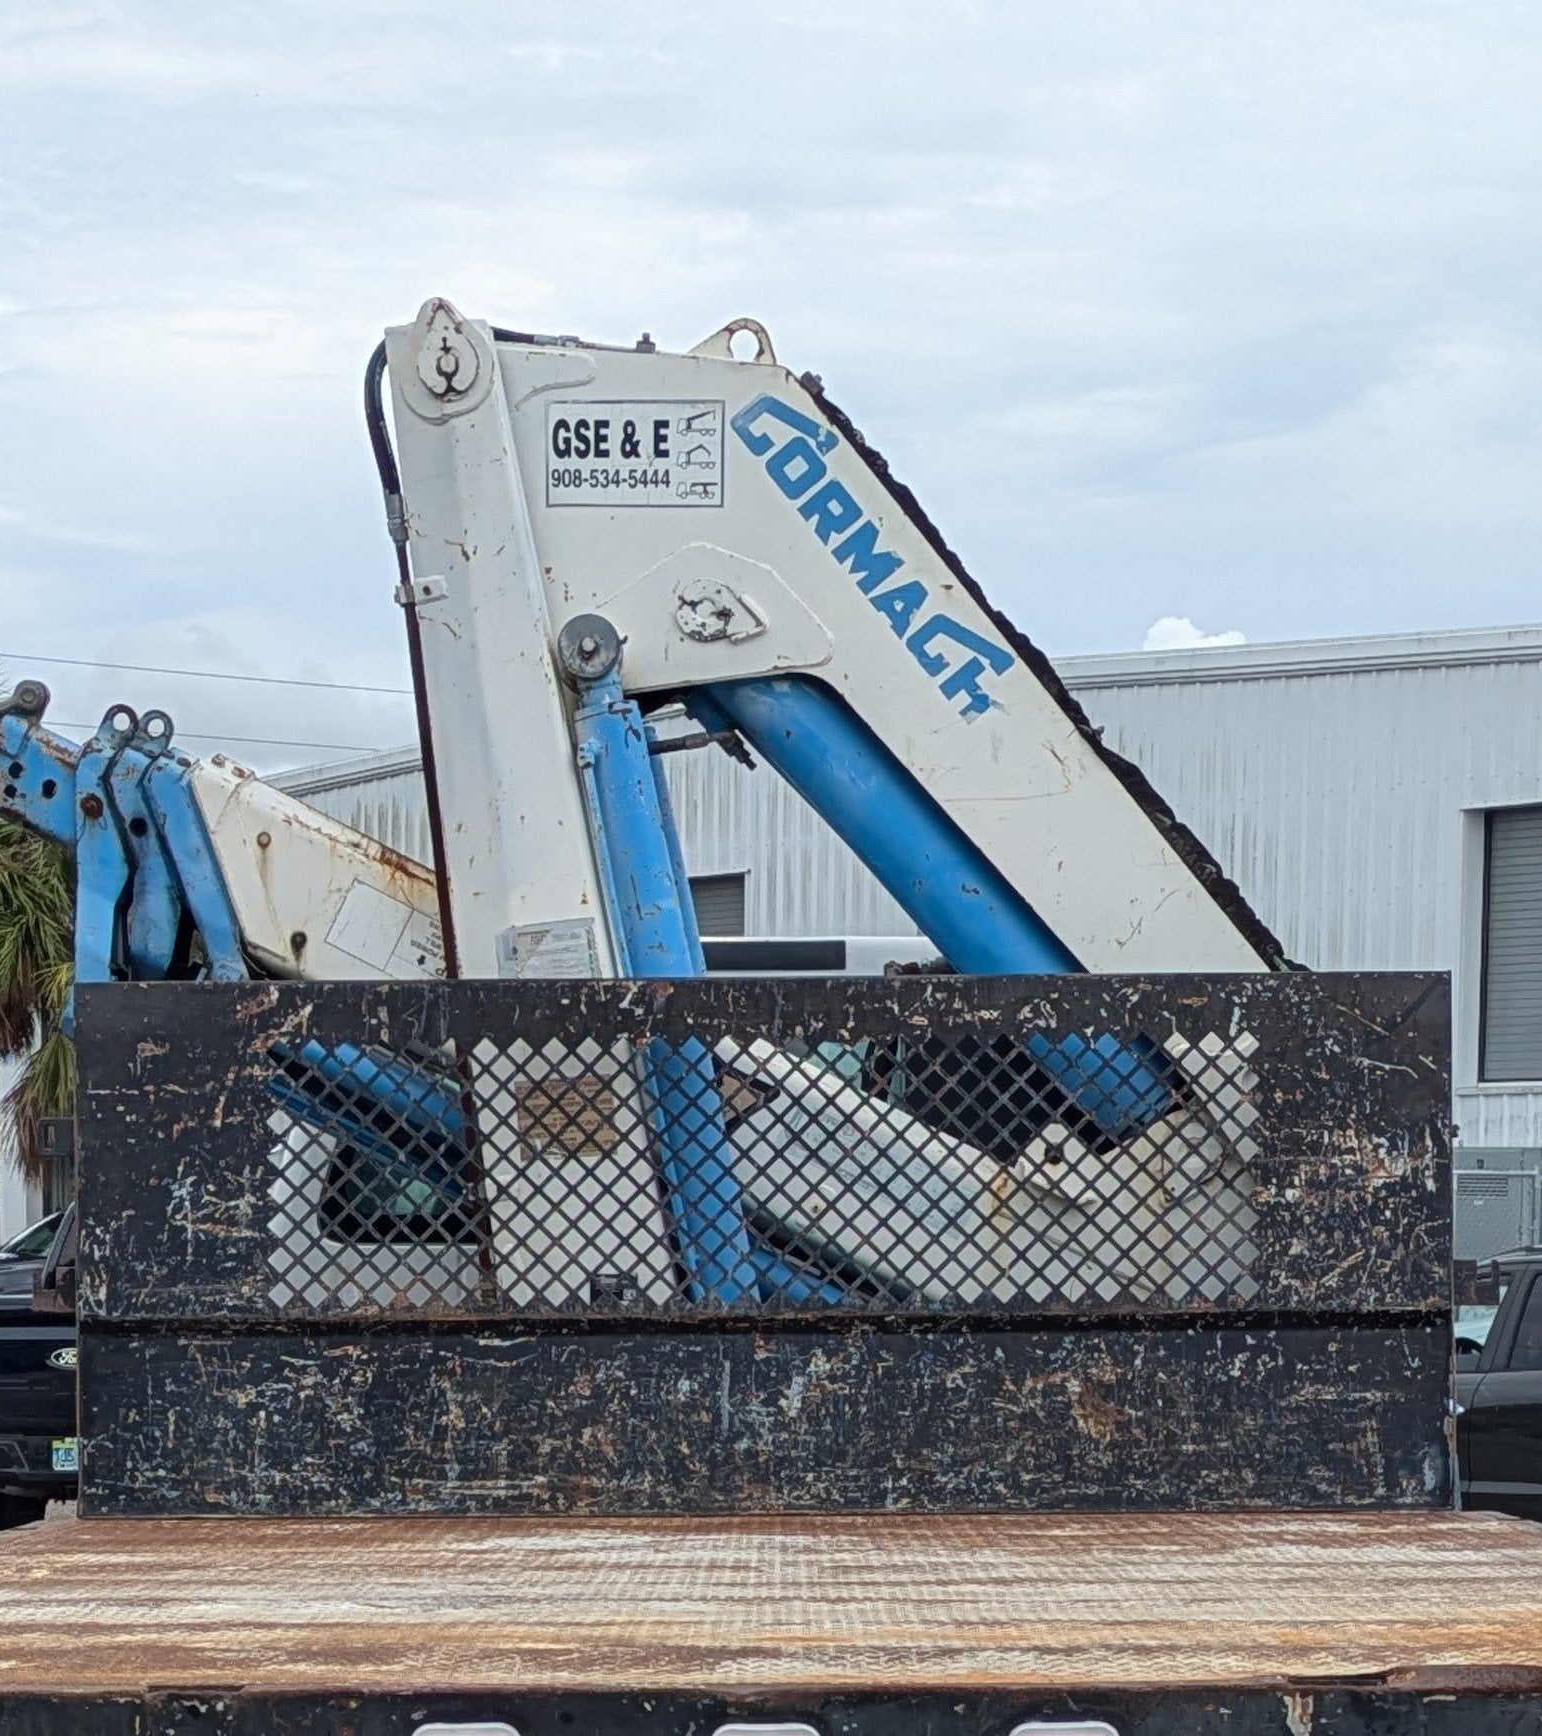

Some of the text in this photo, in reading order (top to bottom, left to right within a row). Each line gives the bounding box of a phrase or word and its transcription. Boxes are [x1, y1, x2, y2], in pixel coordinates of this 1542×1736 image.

[552, 418, 671, 460] GSE & E
[551, 468, 672, 489] 908-534-5444
[730, 394, 1015, 724] CORMACH
